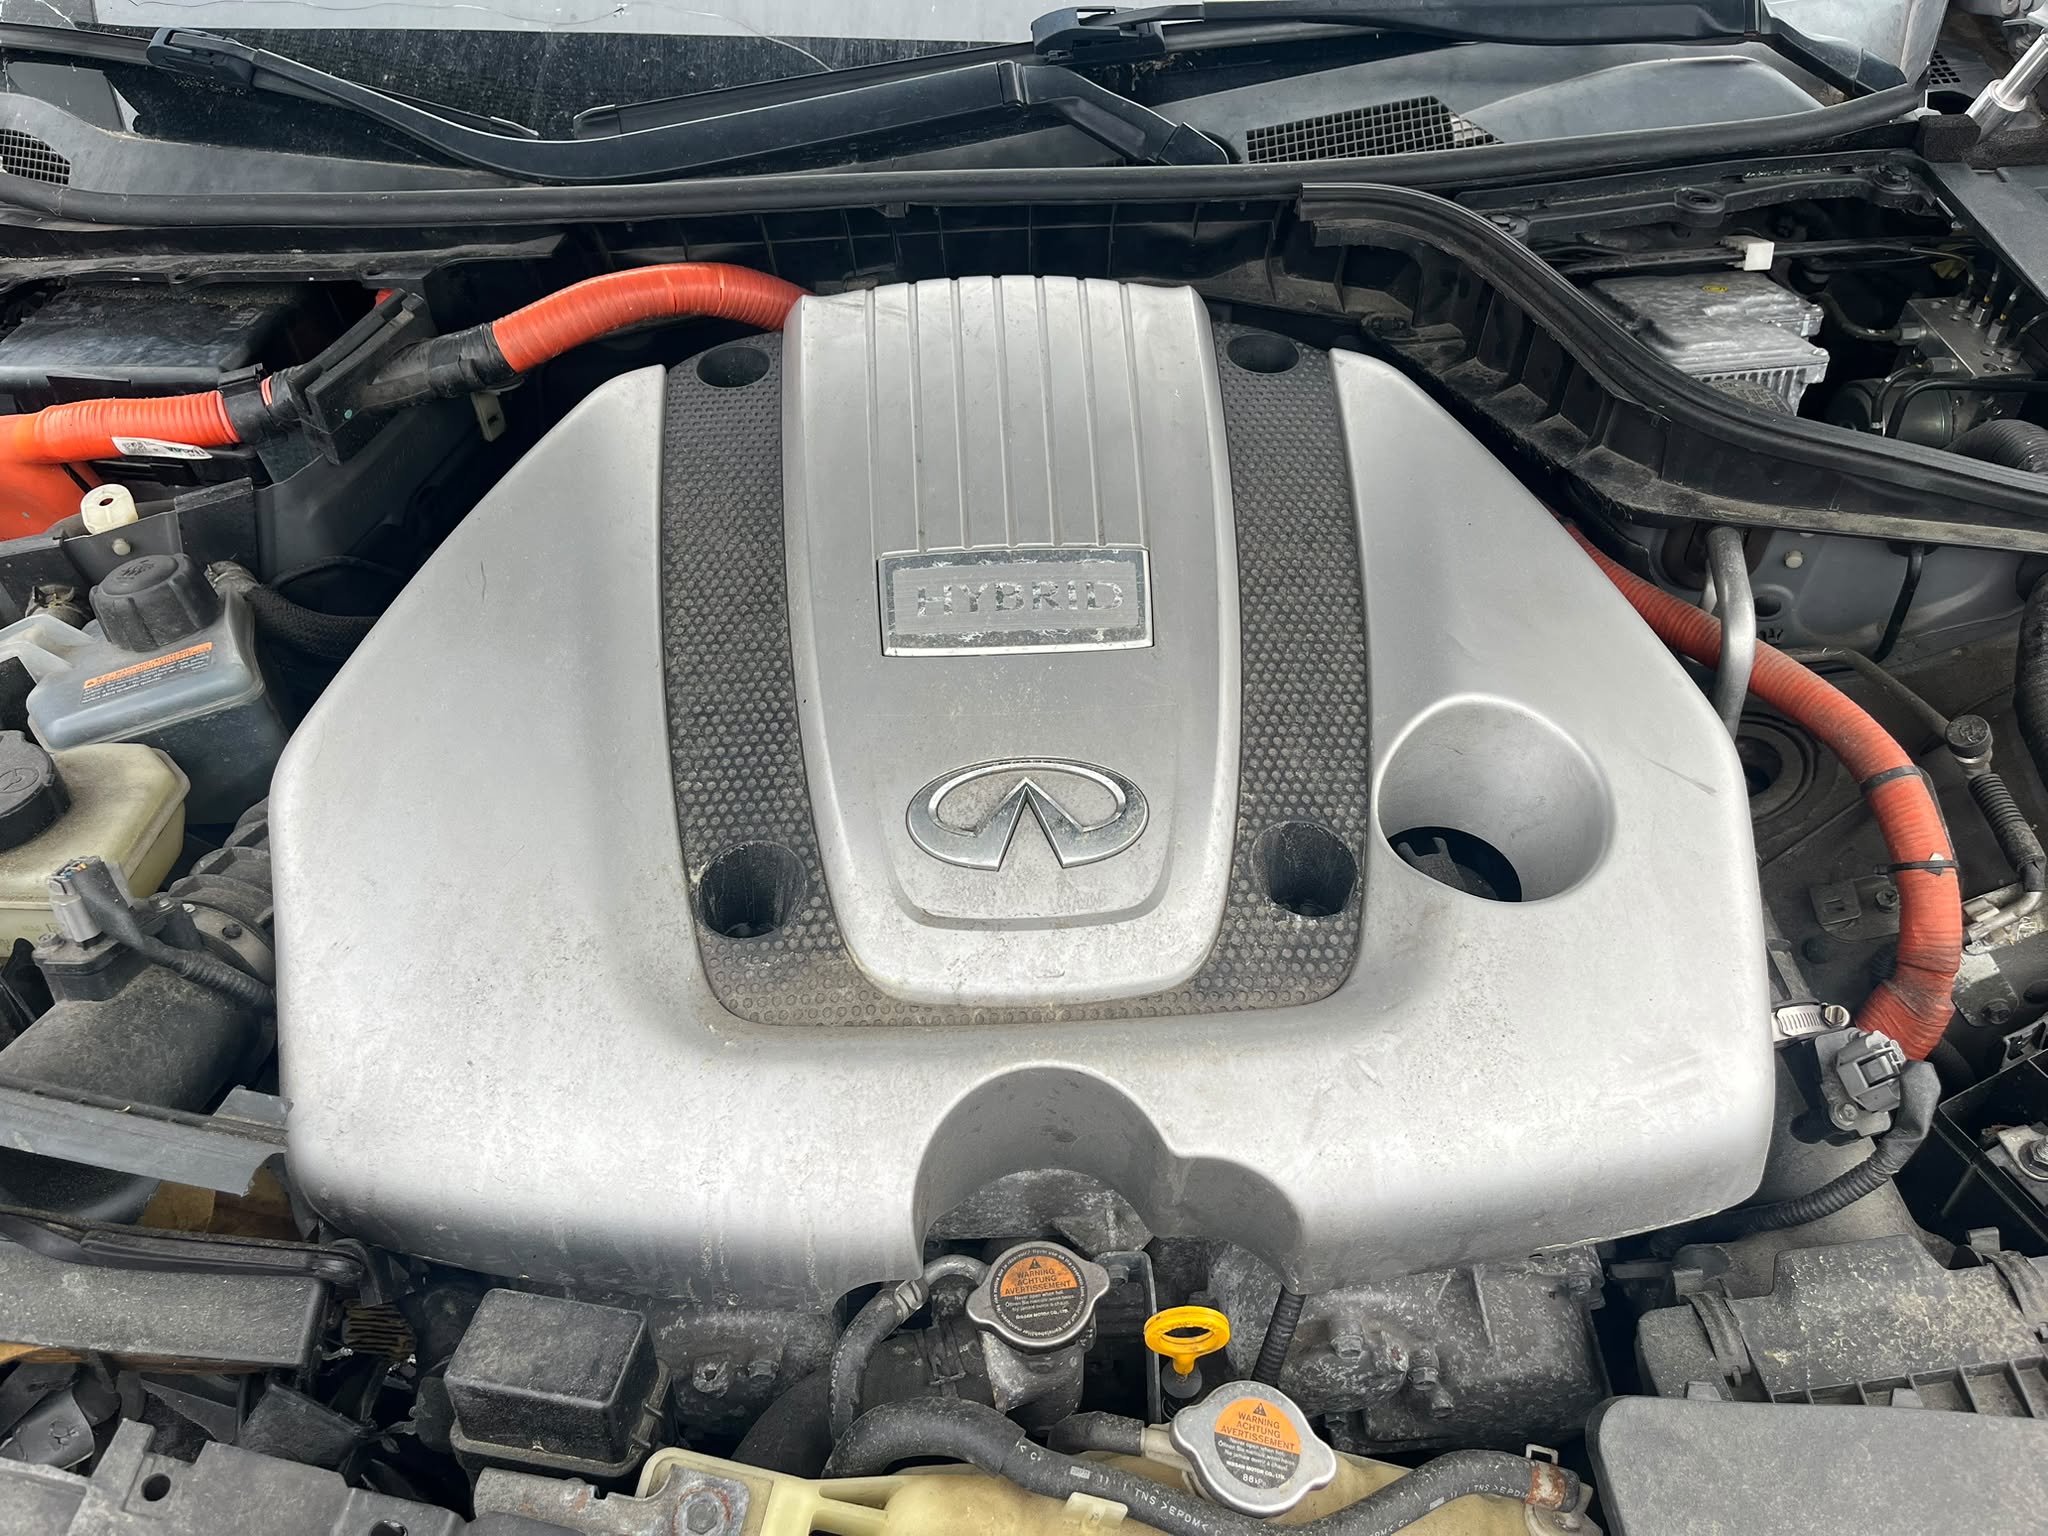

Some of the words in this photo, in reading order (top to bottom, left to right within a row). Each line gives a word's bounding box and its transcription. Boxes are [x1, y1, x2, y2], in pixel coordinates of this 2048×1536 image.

[917, 580, 1124, 617] HYBRID
[1017, 1275, 1057, 1286] ACHTUNG
[1018, 1268, 1055, 1279] WARNING
[1005, 1280, 1070, 1295] AVERTISSEMENT
[1238, 1412, 1280, 1429] WARNING
[1237, 1421, 1281, 1438] ACHTUNG
[1221, 1426, 1295, 1451] AVERTISSEMENT
[1134, 1488, 1157, 1506] TNS
[1473, 1484, 1490, 1493] TNS
